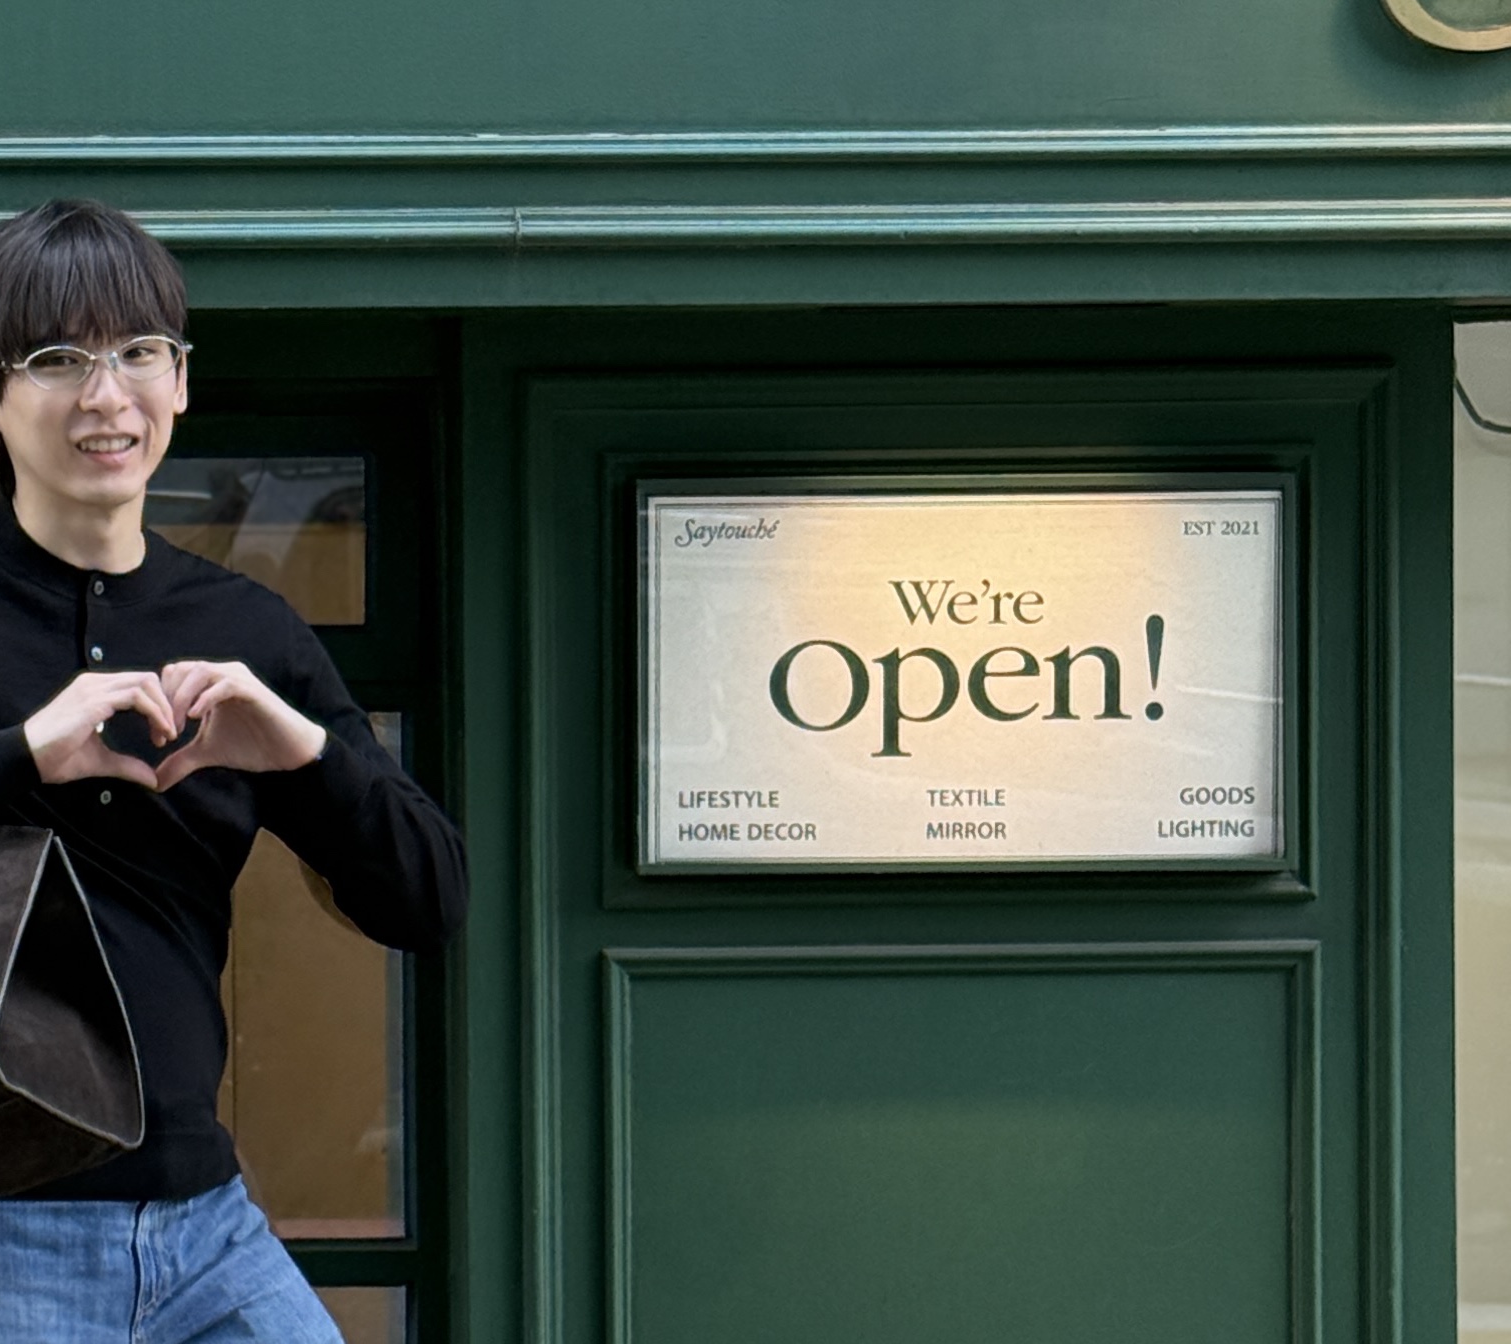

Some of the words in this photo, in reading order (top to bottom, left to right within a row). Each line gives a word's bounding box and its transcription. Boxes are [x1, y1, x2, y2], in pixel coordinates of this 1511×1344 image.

[674, 517, 780, 548] Saytouché
[1182, 520, 1216, 536] EST
[1220, 520, 1259, 536] 2021
[888, 579, 1045, 626] We're
[678, 790, 780, 809] LIFESTYLE
[926, 788, 1007, 807] TEXTILE
[1179, 786, 1256, 806] GOODS
[678, 822, 741, 842] HOME
[747, 822, 818, 842] DECOR
[926, 821, 1008, 840] MIRROR
[1157, 819, 1256, 839] LIGHTING
